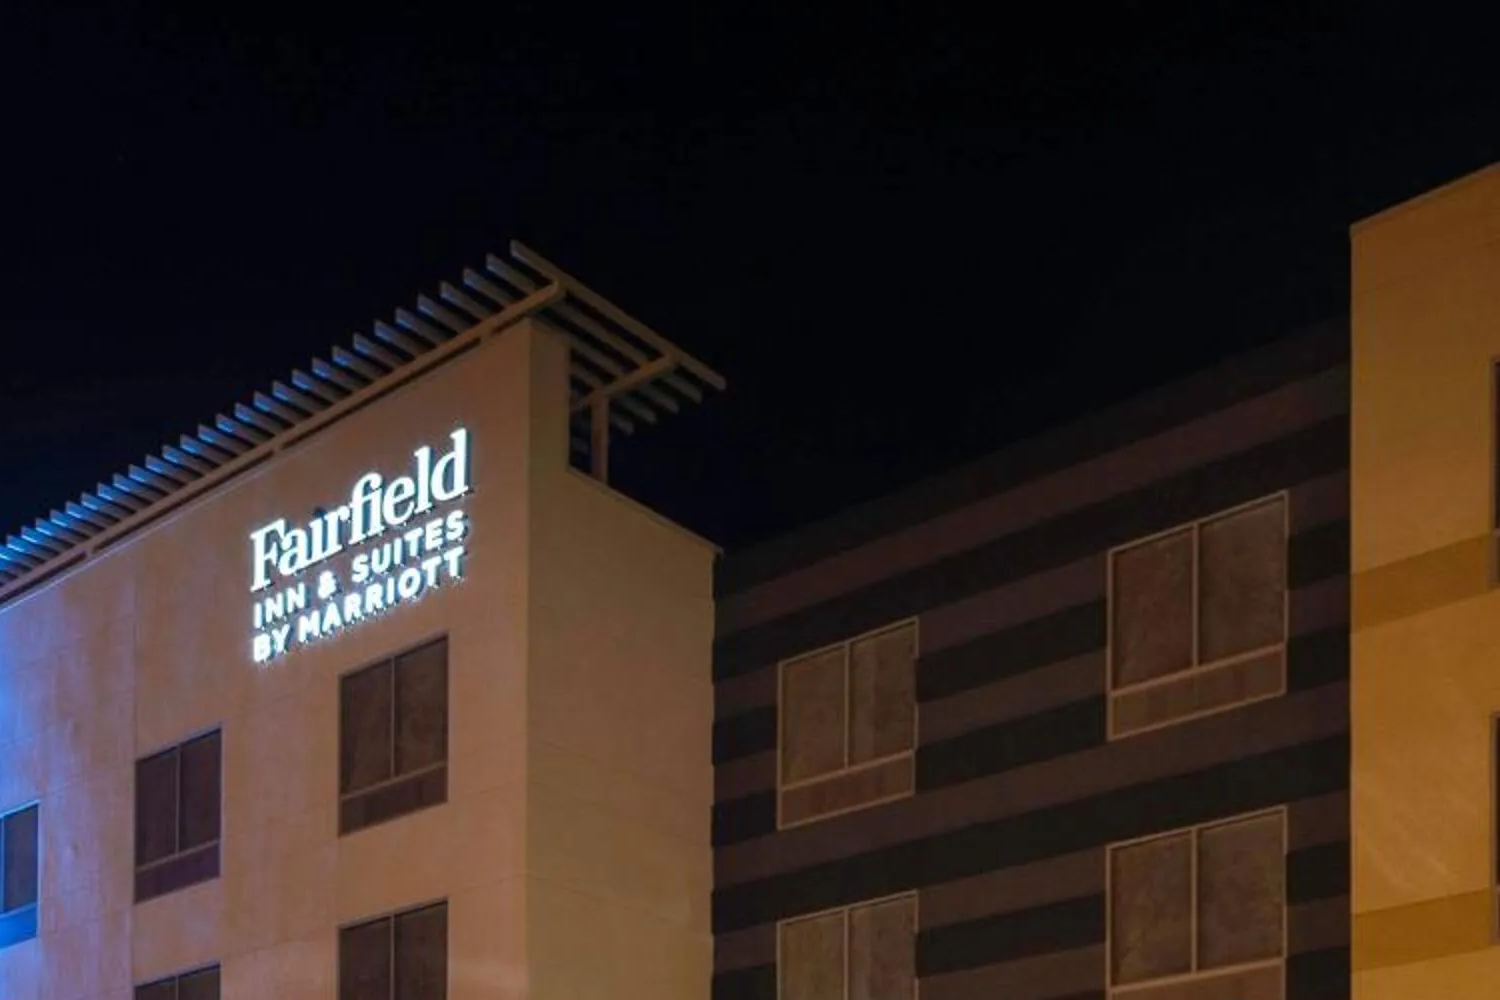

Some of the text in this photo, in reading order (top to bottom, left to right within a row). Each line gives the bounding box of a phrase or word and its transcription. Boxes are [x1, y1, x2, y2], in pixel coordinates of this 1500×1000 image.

[250, 427, 469, 592] Fairfield
[254, 509, 467, 629] INN & SUITES
[253, 546, 465, 663] BY MARRIOTT
